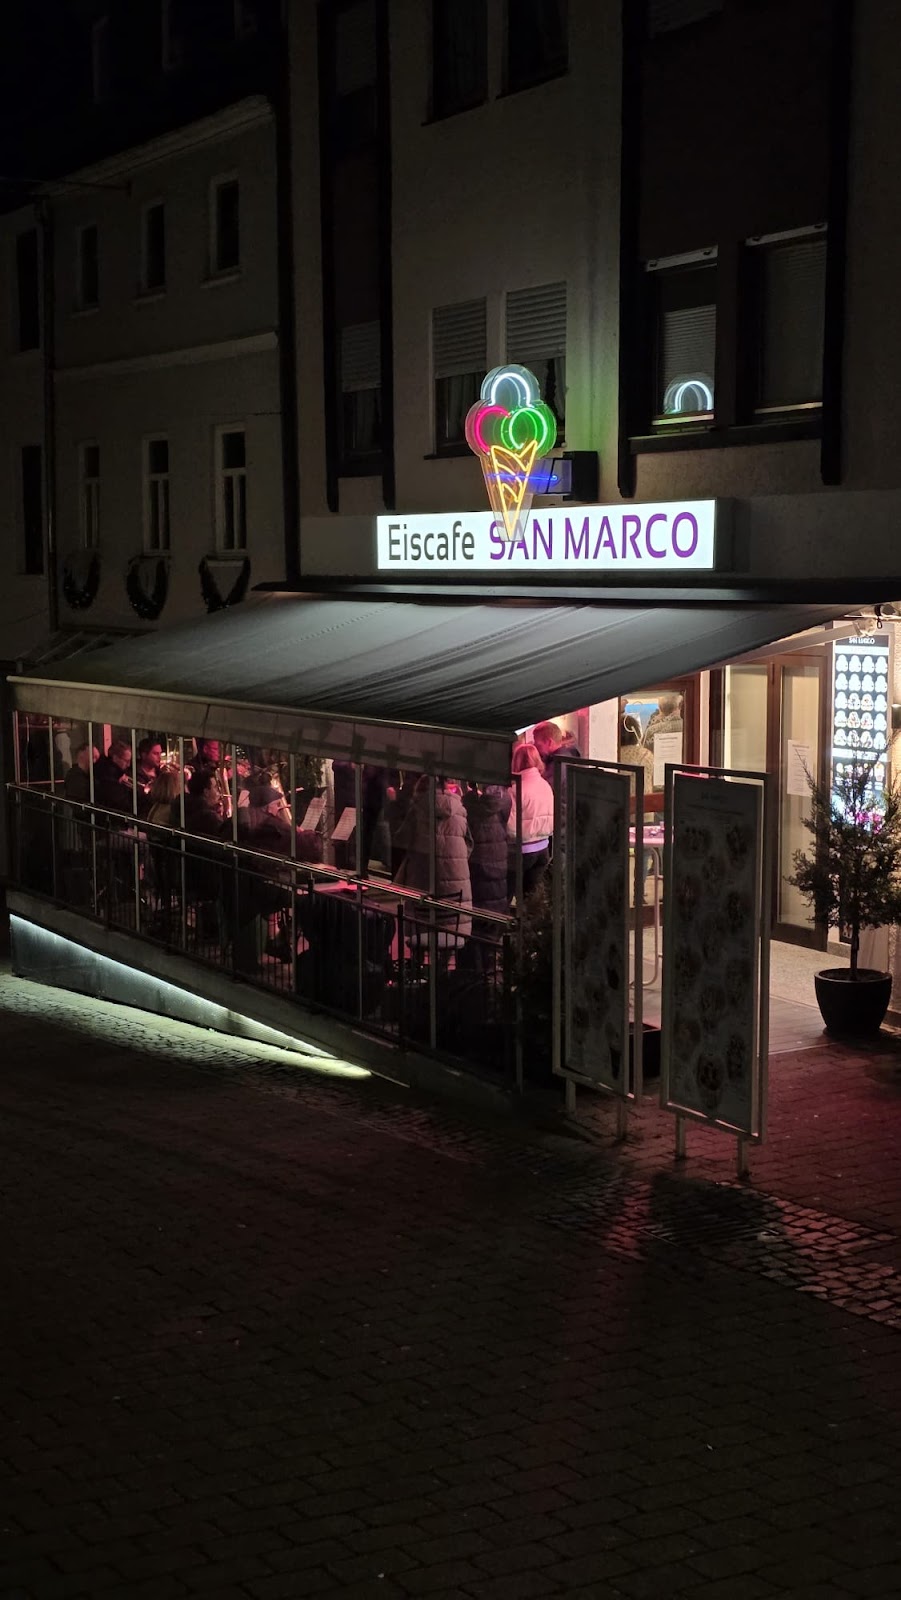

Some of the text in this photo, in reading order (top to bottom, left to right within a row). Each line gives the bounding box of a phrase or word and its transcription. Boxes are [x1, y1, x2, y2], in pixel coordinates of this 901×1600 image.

[388, 511, 699, 561] Eiscafe SAN MARCO
